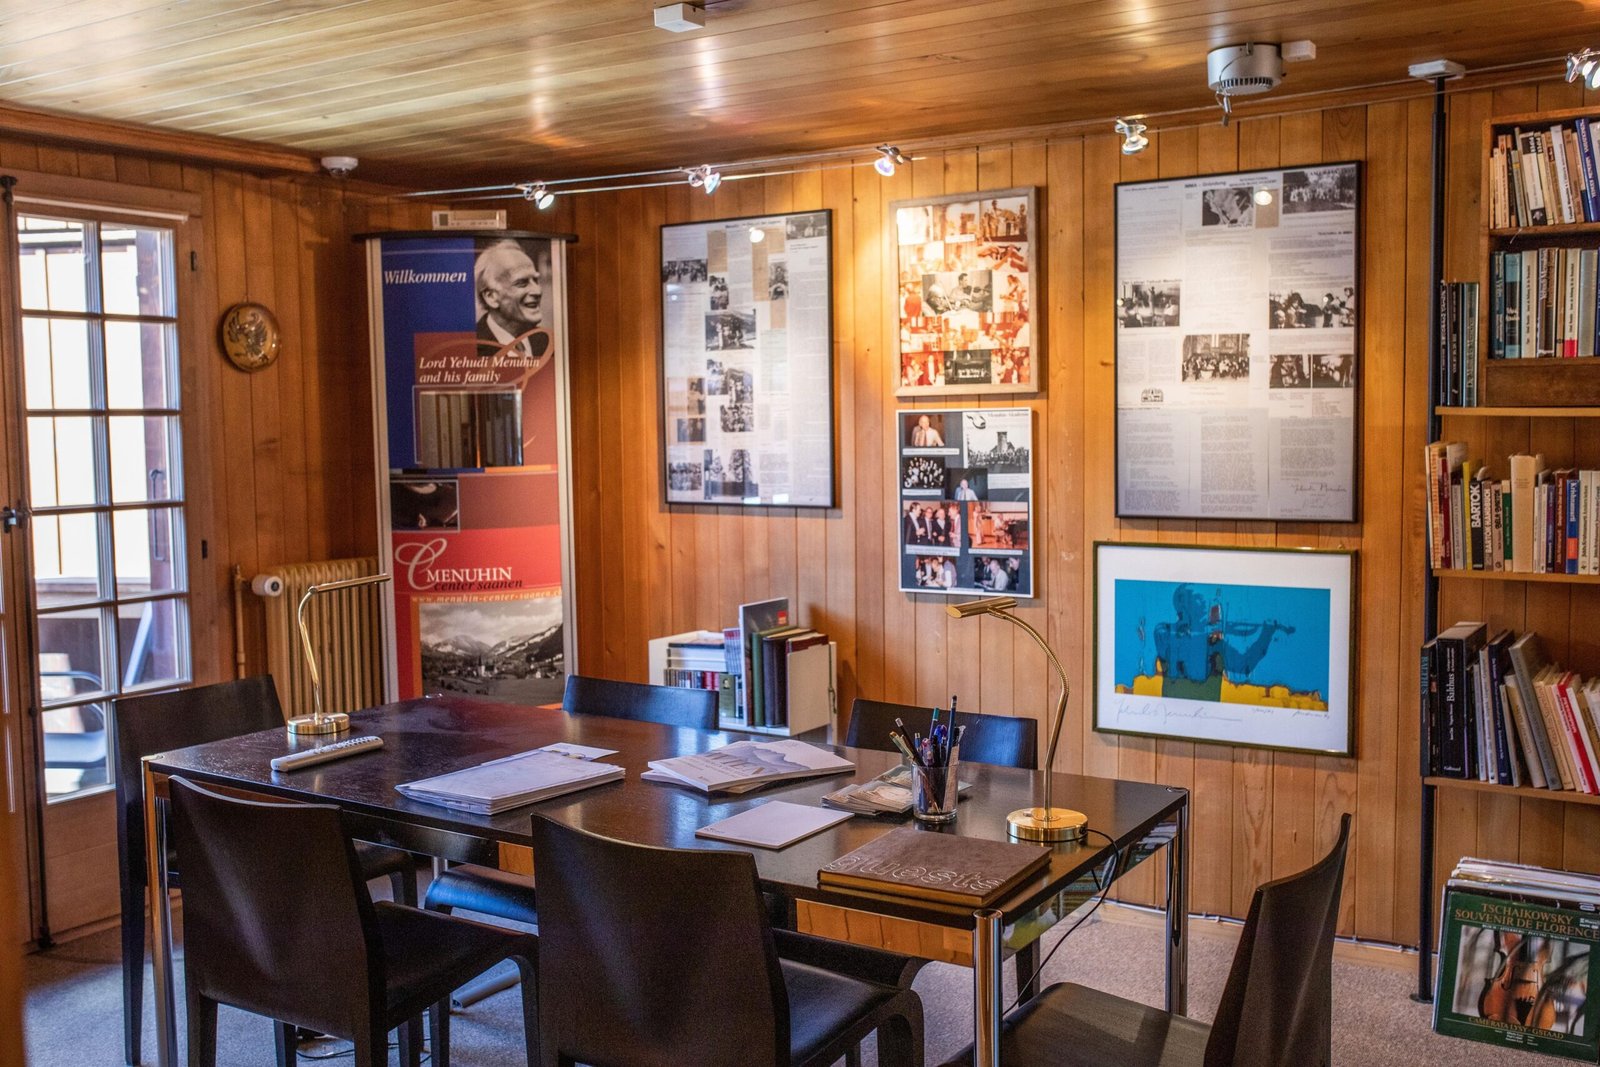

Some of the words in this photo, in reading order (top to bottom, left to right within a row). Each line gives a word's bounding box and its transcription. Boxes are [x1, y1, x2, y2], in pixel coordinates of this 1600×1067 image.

[384, 269, 467, 286] Willkommen
[419, 356, 446, 369] Lord
[450, 355, 489, 369] Yehudi
[491, 356, 540, 368] Menuhin
[419, 371, 441, 384] and
[443, 370, 461, 383] his
[462, 369, 501, 385] family
[1469, 483, 1482, 529] BARTOK
[1568, 482, 1577, 523] Krishnamurti
[426, 566, 513, 583] MENUHIN
[433, 580, 473, 592] center
[476, 580, 523, 591] saanen
[1446, 673, 1455, 702] Balthus
[822, 855, 1006, 891] guests
[1455, 908, 1514, 927] SOUVENIR
[1516, 917, 1533, 930] DE
[1535, 920, 1600, 940] FLORENCE
[1481, 903, 1574, 926] TSCHAIKOWSKY
[1468, 1016, 1509, 1030] CAMERATA
[1531, 1028, 1564, 1040] GSTAAD
